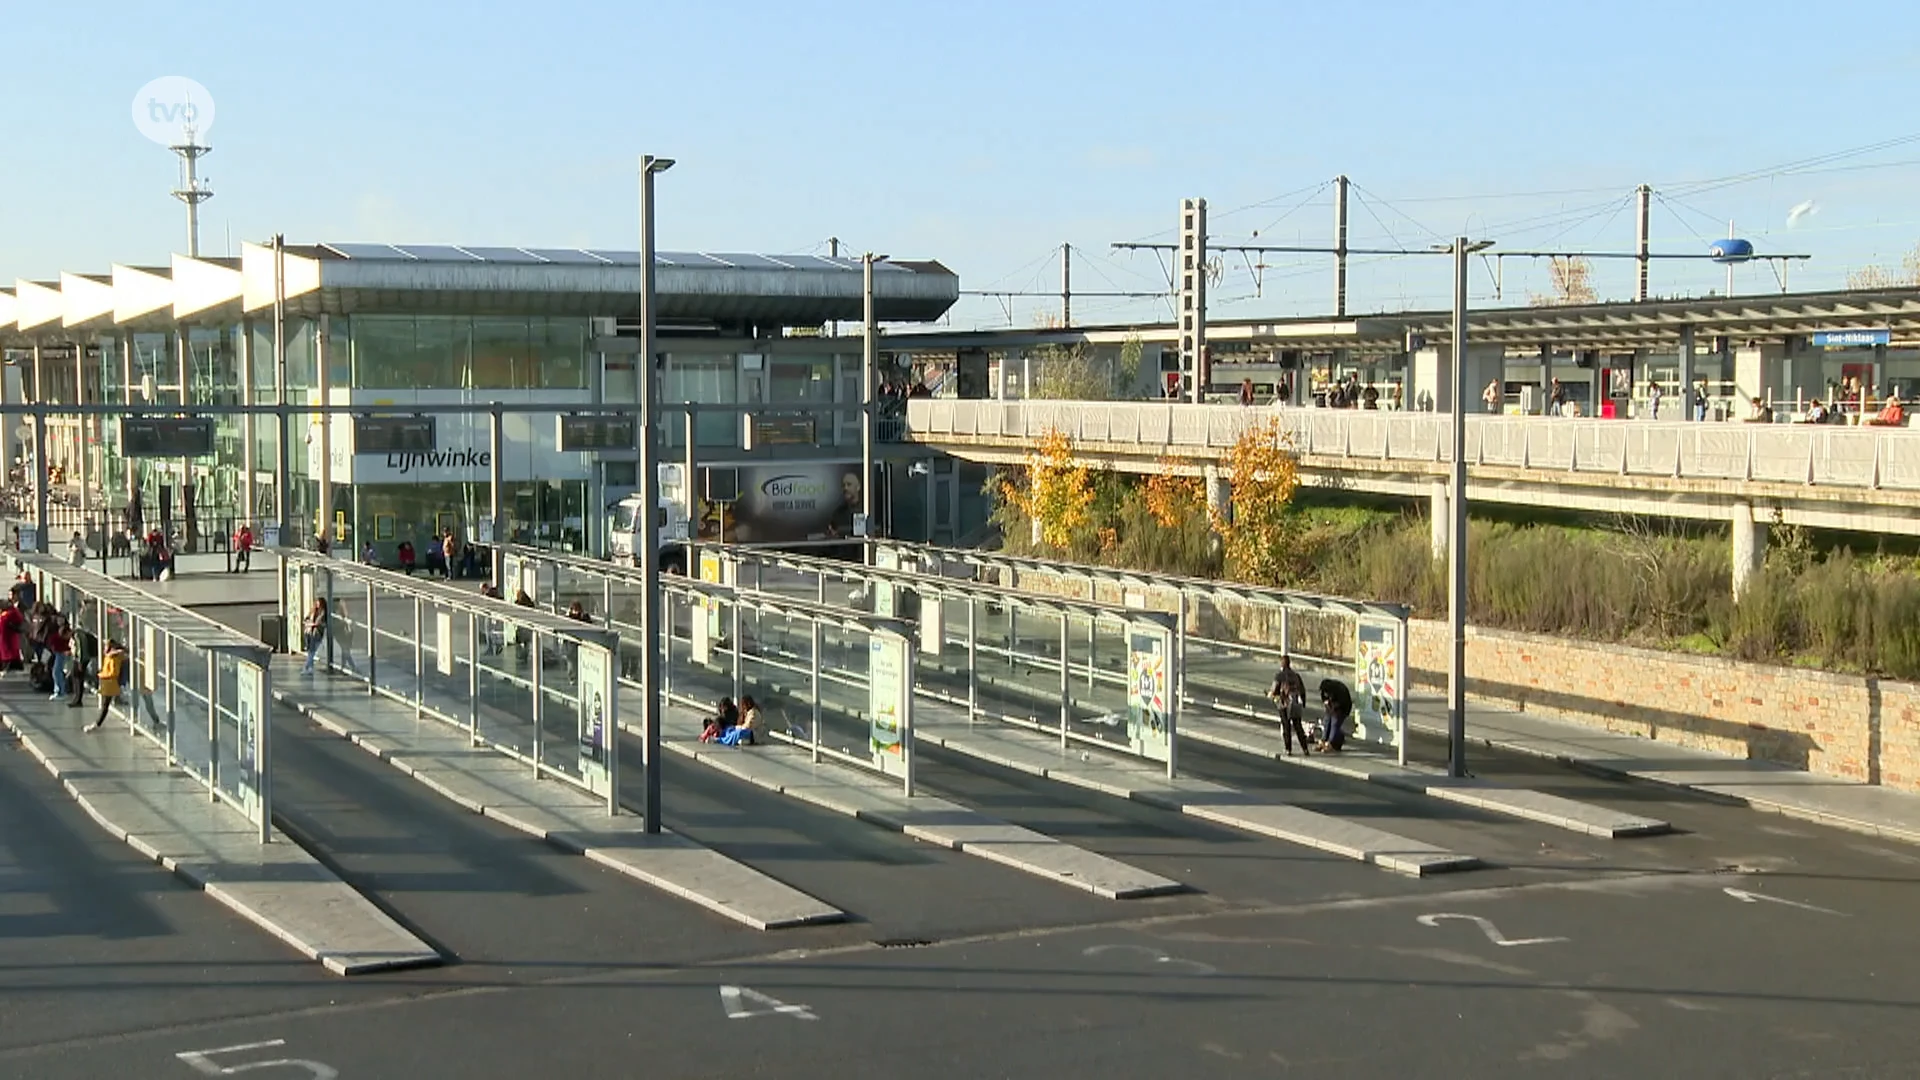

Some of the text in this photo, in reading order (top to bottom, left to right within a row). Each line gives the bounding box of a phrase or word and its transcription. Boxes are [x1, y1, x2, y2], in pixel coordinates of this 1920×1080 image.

[1826, 333, 1874, 343] Sint-Niklaas
[386, 447, 492, 474] Lijnwinke
[771, 482, 826, 496] Bidfood
[1415, 912, 1570, 947] 2
[719, 985, 818, 1020] 4
[176, 1038, 339, 1080] 5
